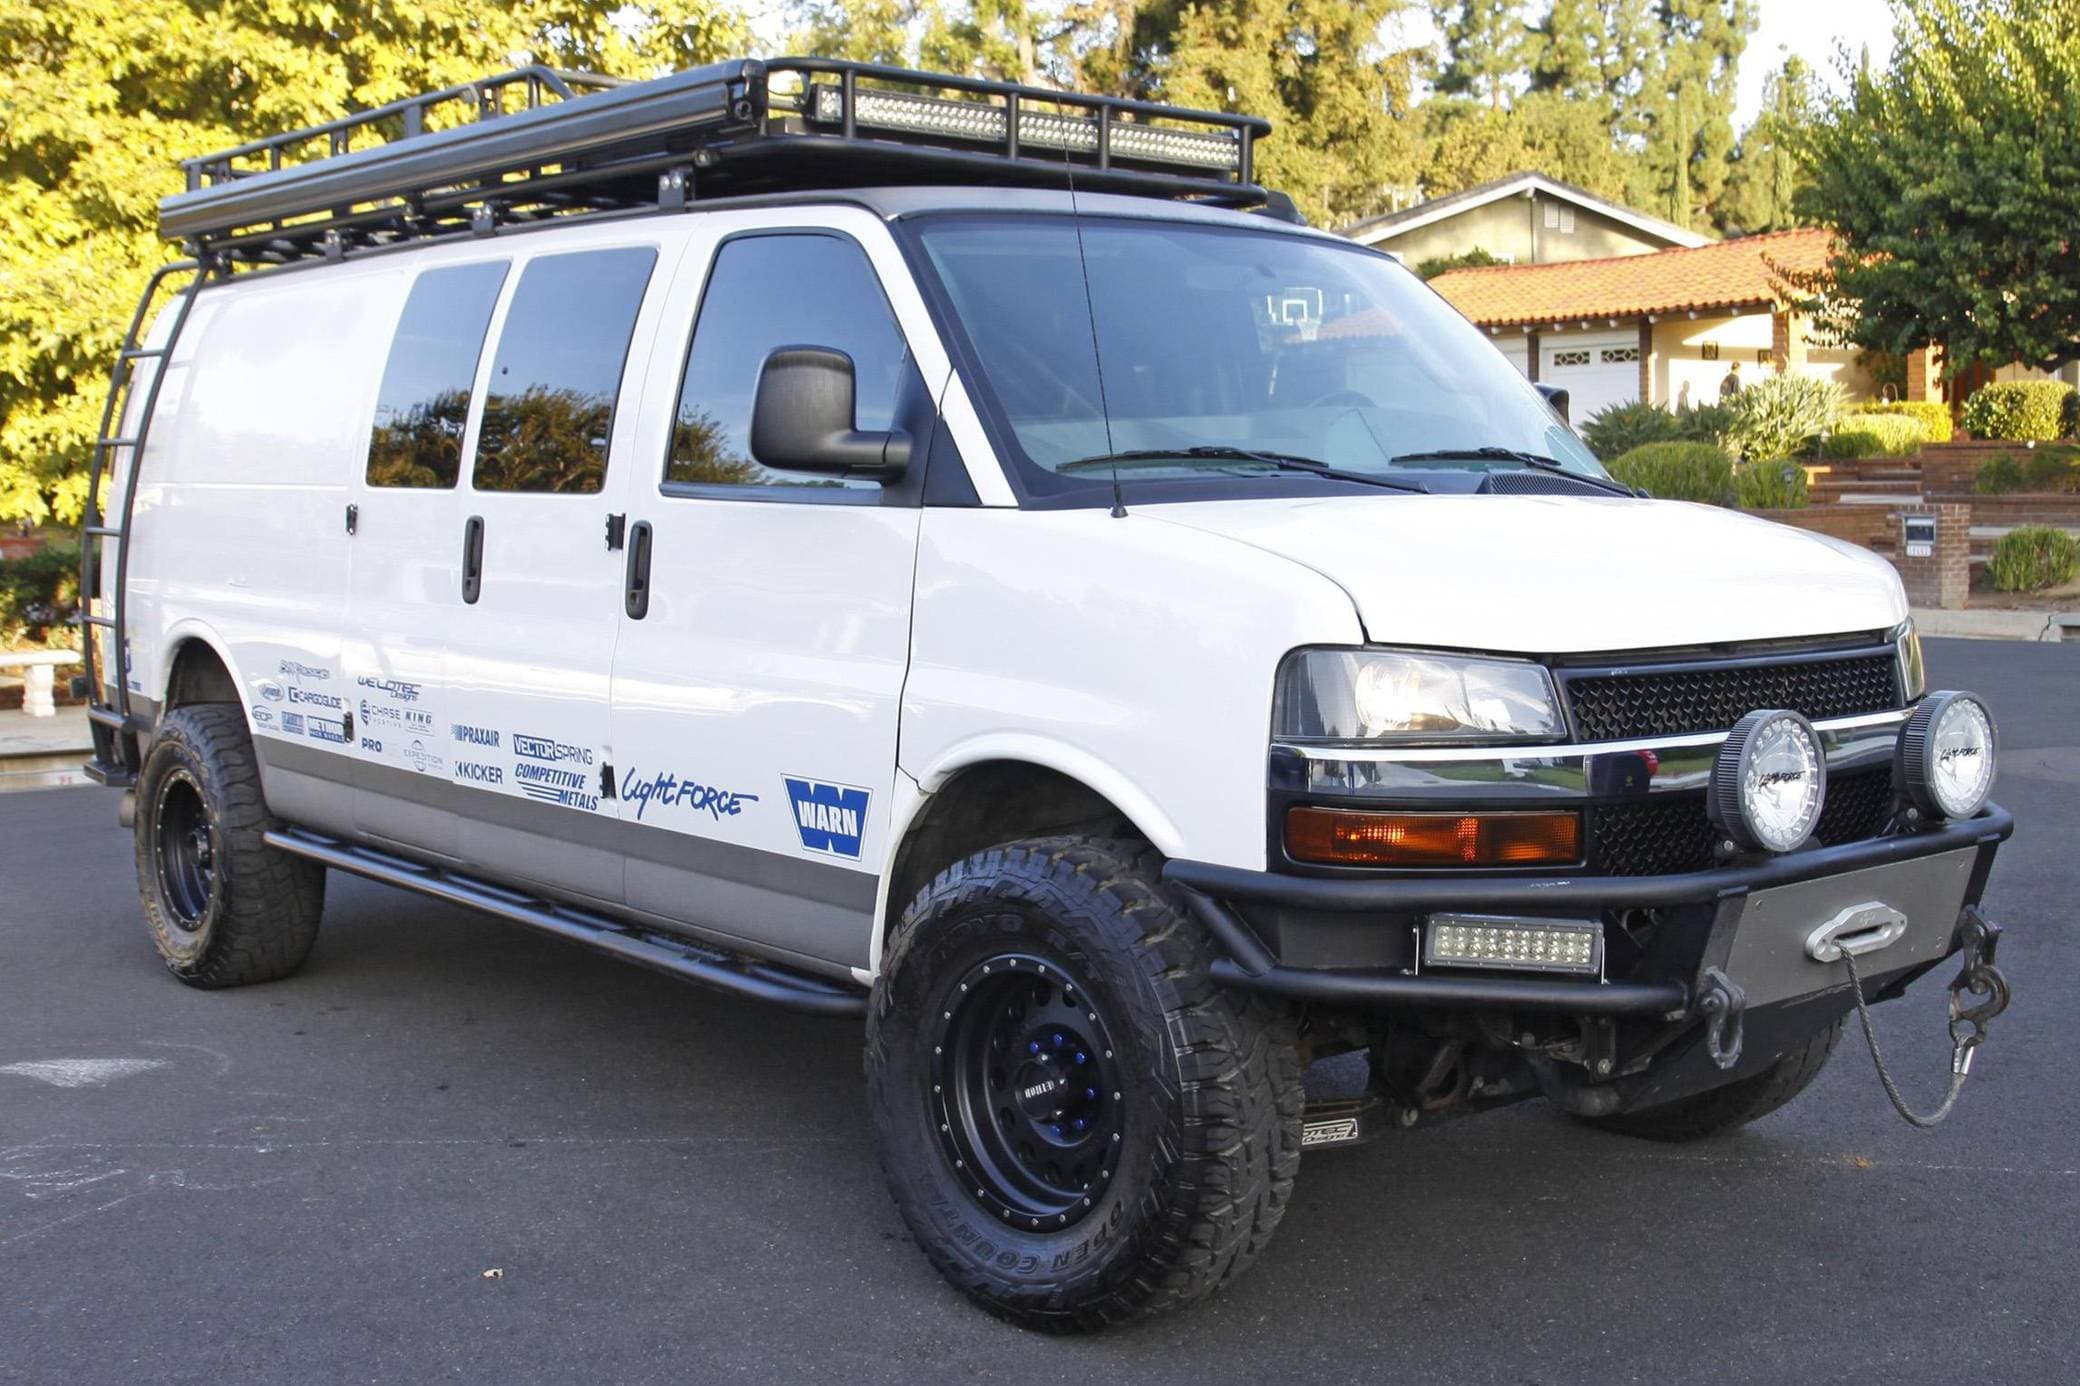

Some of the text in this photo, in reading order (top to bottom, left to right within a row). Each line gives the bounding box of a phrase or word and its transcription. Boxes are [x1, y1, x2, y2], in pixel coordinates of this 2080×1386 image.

[405, 711, 432, 724] KING
[361, 737, 382, 753] PRO
[463, 725, 500, 748] PRAXAIR
[555, 743, 593, 766] SPRING
[463, 761, 503, 785] KICKER
[515, 762, 587, 790] COMPETITIVE
[558, 788, 599, 811] METALS
[797, 799, 859, 838] WARN
